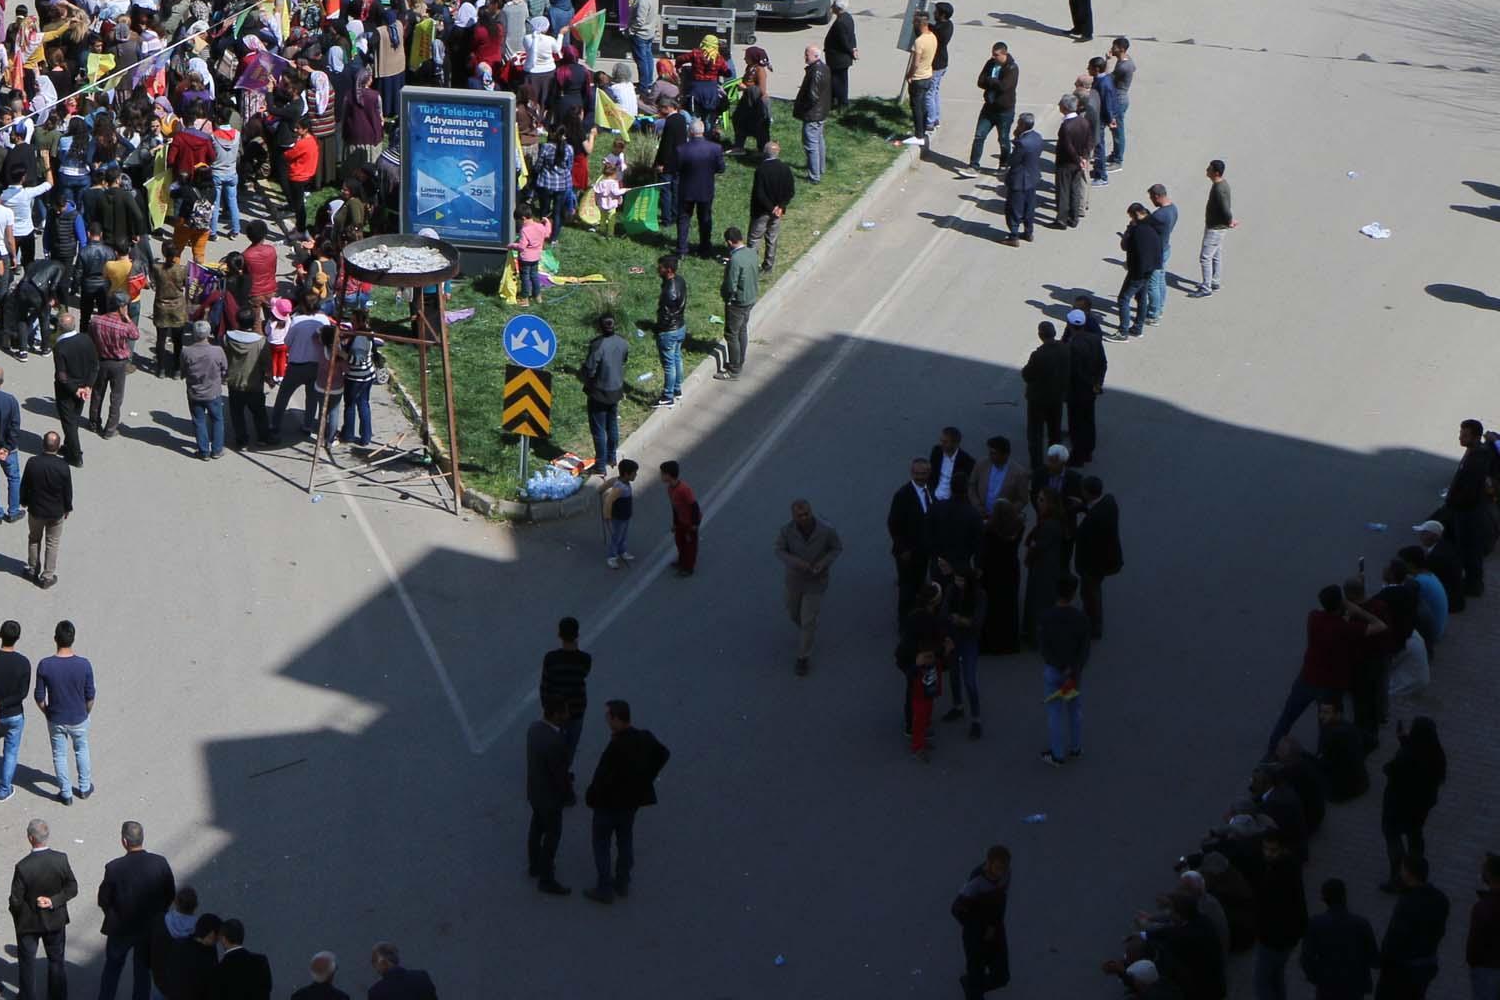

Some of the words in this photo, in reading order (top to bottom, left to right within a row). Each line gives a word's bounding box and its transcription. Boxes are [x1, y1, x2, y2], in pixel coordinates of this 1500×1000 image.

[418, 105, 440, 114] Türk
[424, 115, 488, 129] Adıyaman'da
[440, 136, 485, 147] kalmasın
